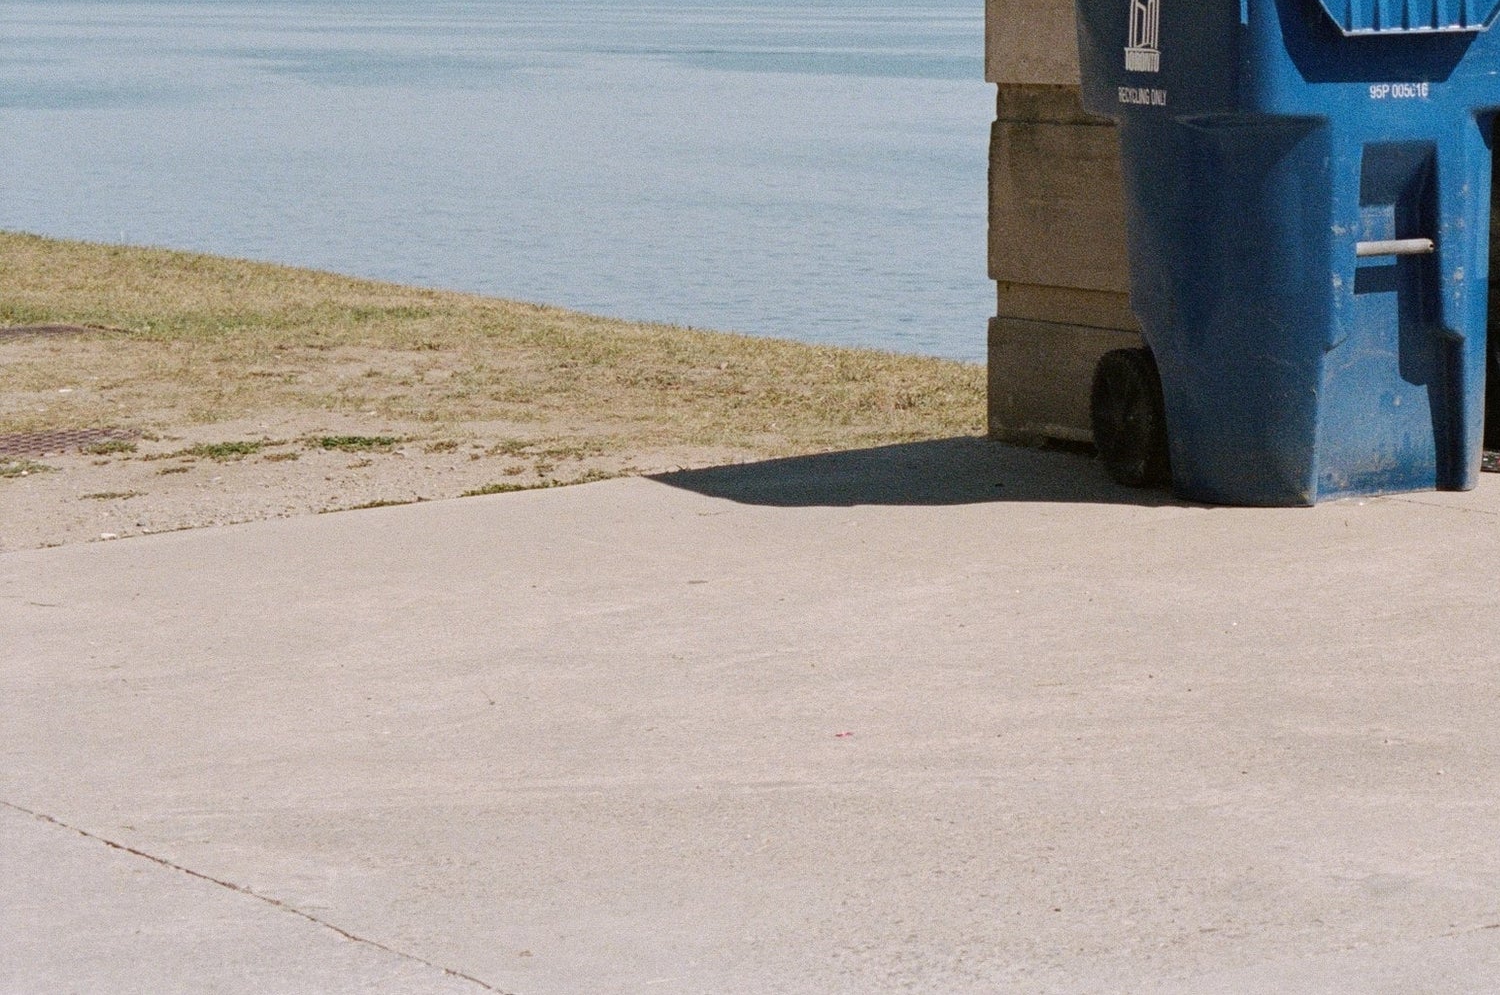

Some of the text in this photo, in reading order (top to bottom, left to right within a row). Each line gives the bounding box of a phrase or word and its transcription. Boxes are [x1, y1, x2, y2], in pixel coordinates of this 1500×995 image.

[1118, 86, 1167, 106] RECYCLING ONLY
[1369, 84, 1390, 99] 95P
